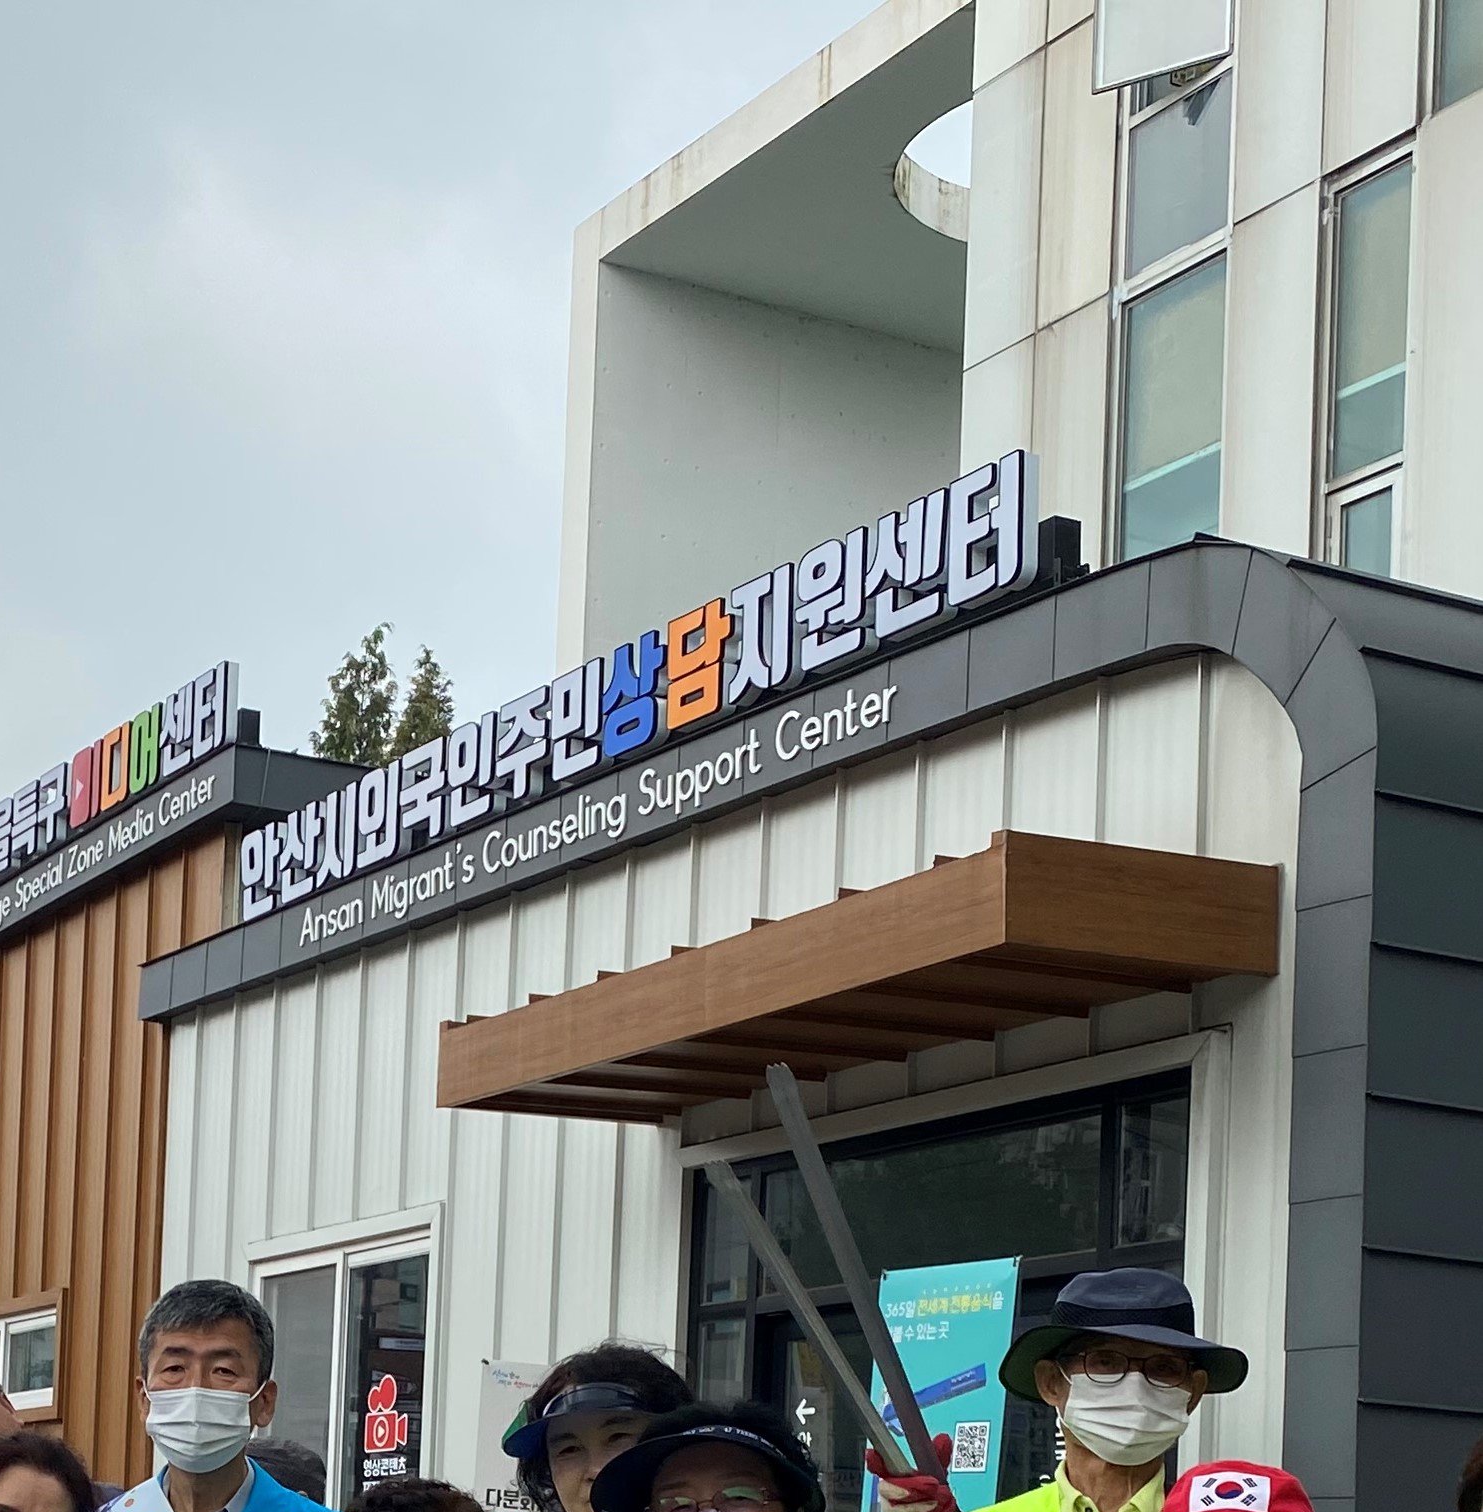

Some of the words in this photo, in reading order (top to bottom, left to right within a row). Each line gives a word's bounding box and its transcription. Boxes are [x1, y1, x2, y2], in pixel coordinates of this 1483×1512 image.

[241, 449, 1038, 922] 안산시외국인주민상담지원센터
[300, 894, 362, 947] Ansan
[370, 841, 475, 926] Migrant's
[483, 790, 626, 875] Counseling
[637, 731, 761, 818] Support
[775, 681, 898, 759] Center
[14, 857, 63, 912] Special
[67, 839, 104, 879] Zone
[108, 808, 154, 859] Media
[158, 774, 216, 826] Center
